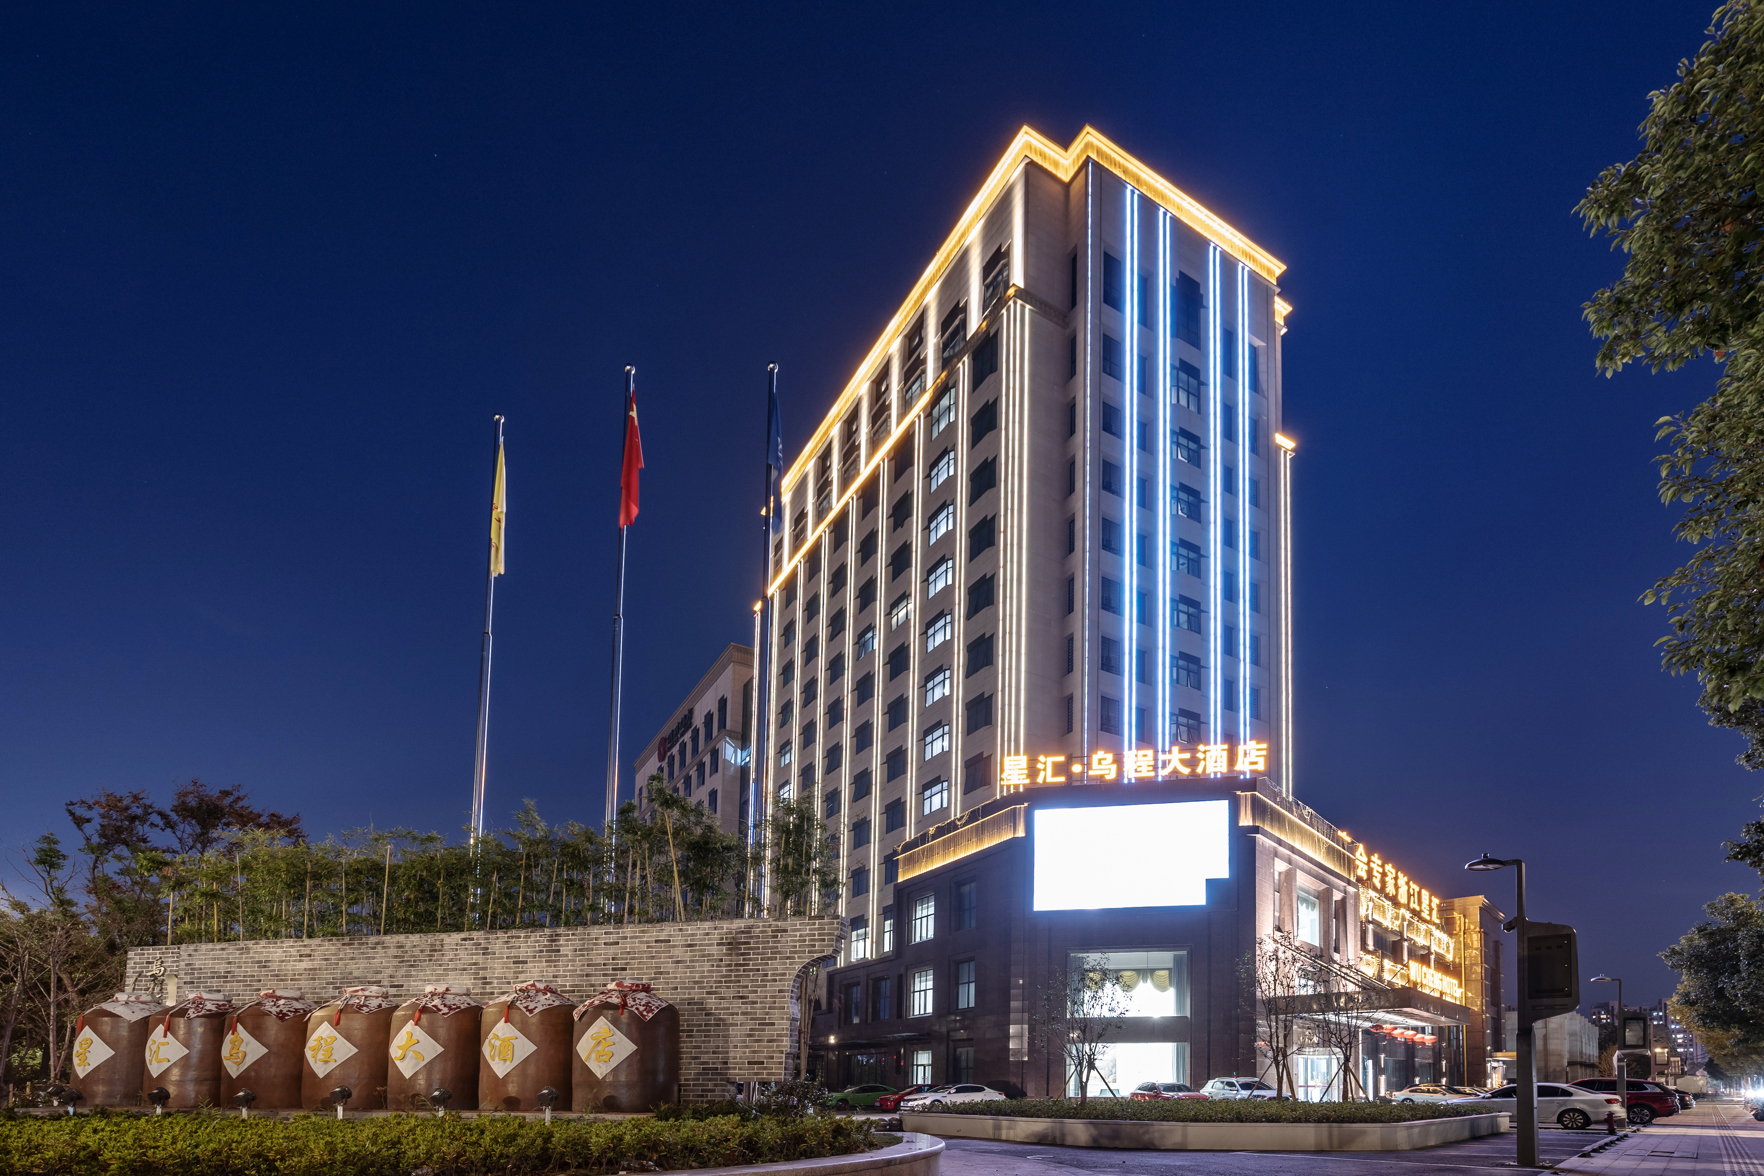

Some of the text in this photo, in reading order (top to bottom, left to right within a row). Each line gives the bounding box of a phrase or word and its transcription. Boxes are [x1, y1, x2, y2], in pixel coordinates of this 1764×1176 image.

[74, 1037, 94, 1067] 星
[148, 1039, 170, 1065] 汇
[308, 1035, 337, 1064] 程
[393, 1031, 424, 1062] 大
[488, 1033, 517, 1063] 酒
[584, 1027, 615, 1063] 店
